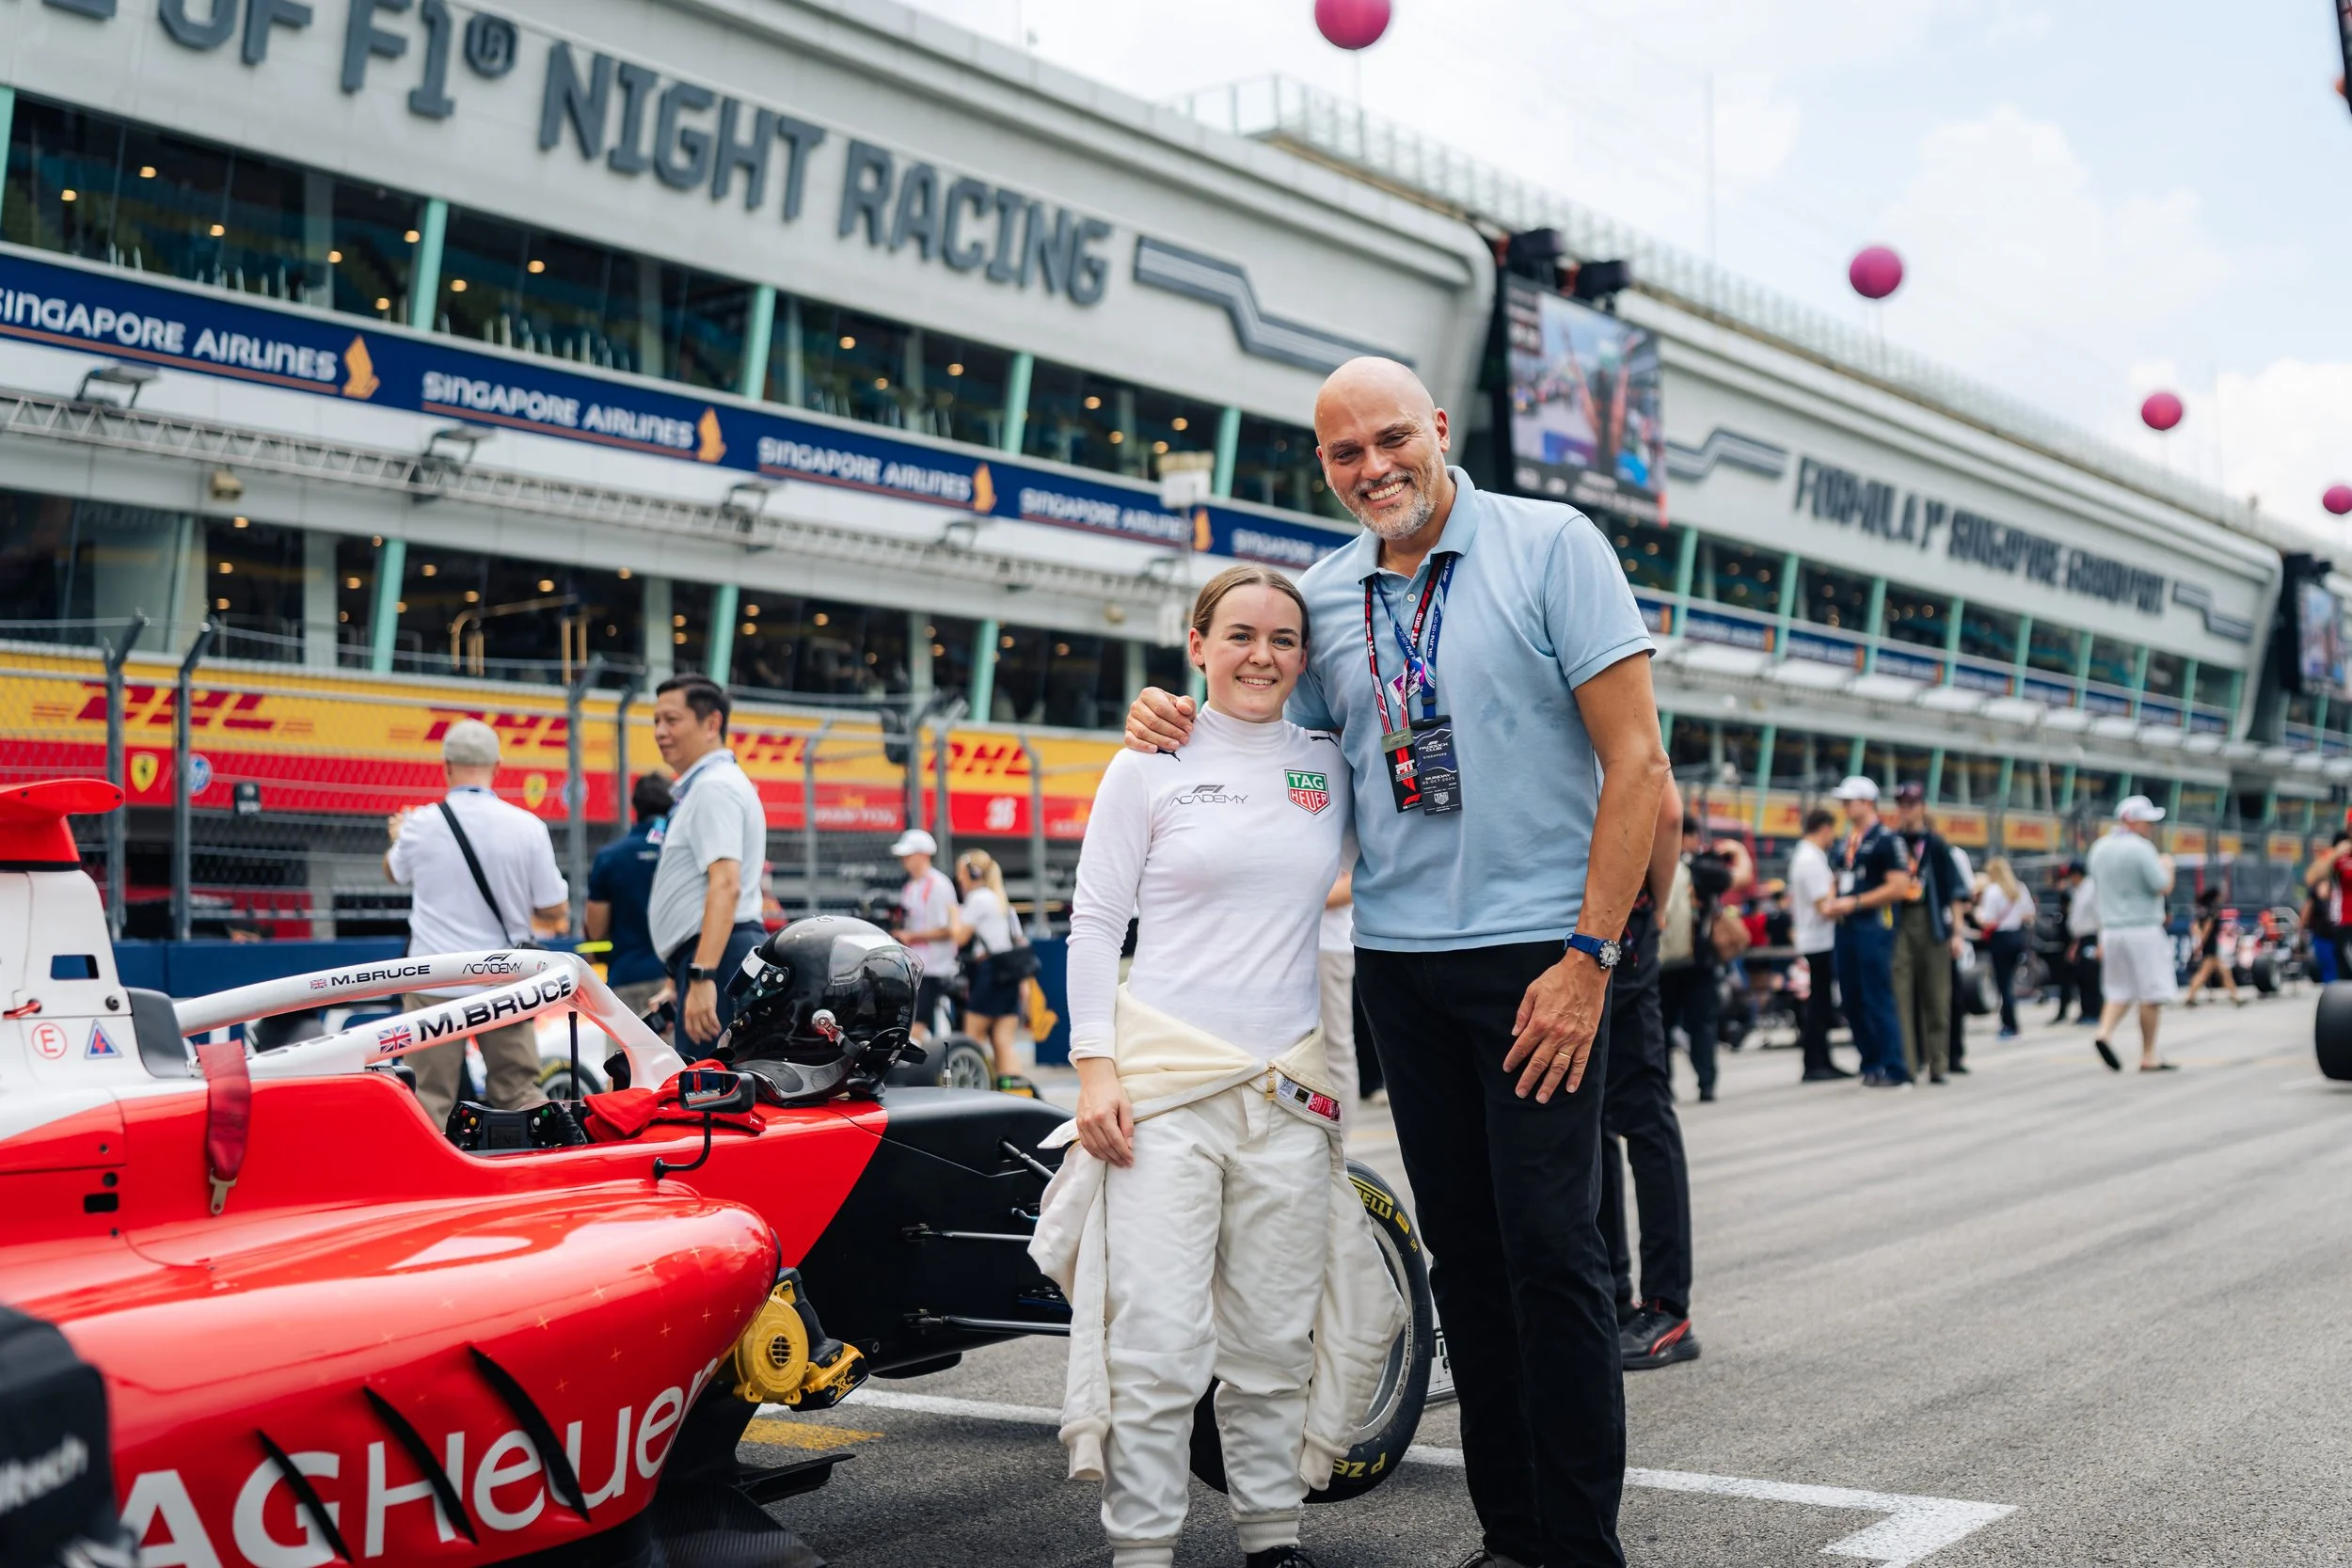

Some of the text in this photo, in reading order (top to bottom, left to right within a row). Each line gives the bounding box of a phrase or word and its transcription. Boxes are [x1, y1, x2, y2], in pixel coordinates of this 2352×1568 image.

[539, 40, 826, 223] NIGHT
[838, 138, 1114, 308] RACING
[193, 327, 337, 382] AIRLINES
[422, 371, 694, 450] SINGAPORE AIRLINES
[757, 436, 973, 501] SINGAPORE AIRLINES
[1169, 794, 1248, 806] ACADEMY
[1289, 774, 1325, 789] TAG
[1291, 790, 1327, 812] HEUER
[331, 964, 431, 987] M.BRUCE
[462, 961, 523, 974] ACADEMY
[418, 974, 572, 1042] M.BRUCE
[119, 1357, 718, 1568] AGHeuer
[1333, 1452, 1386, 1478] P ZE
